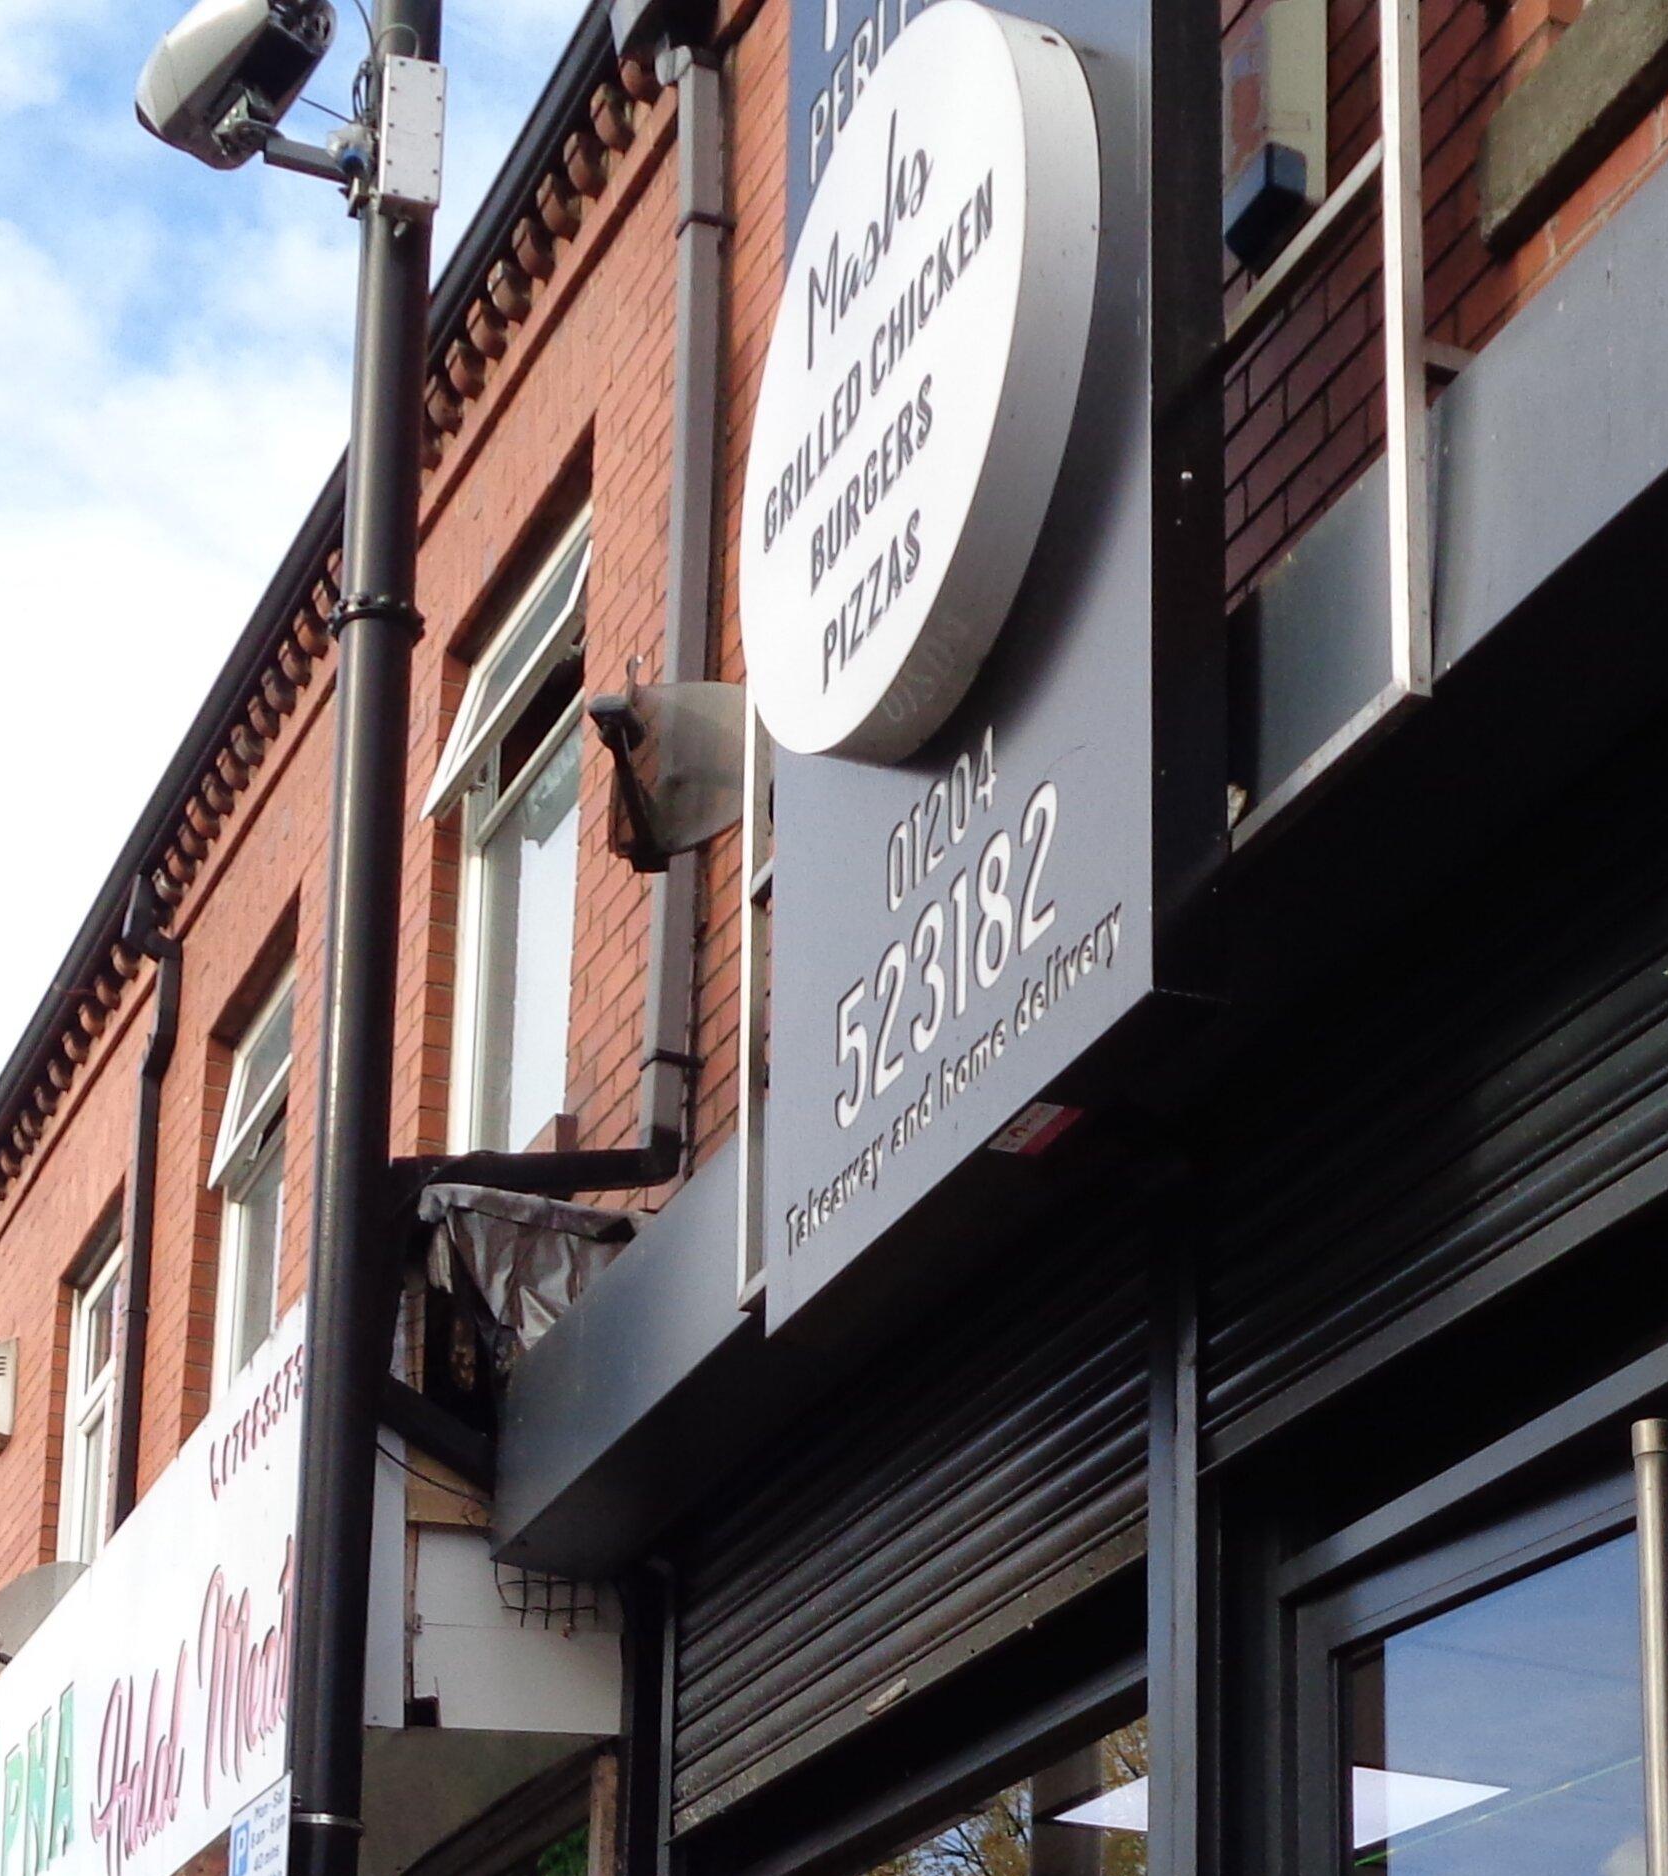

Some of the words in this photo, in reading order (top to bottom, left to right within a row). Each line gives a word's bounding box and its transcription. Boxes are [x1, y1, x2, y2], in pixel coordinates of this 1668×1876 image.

[763, 351, 863, 554] GRILLED
[870, 168, 994, 398] CHICKEN
[807, 109, 934, 370] Mashs
[810, 373, 933, 597] BURGERS
[822, 508, 921, 694] PIZZAS
[886, 724, 997, 911] 01204
[786, 1130, 885, 1256] Takeaway
[890, 1073, 933, 1151] and
[939, 1018, 1006, 1110] home
[1014, 902, 1122, 1038] delivery
[835, 780, 1059, 1130] 523182
